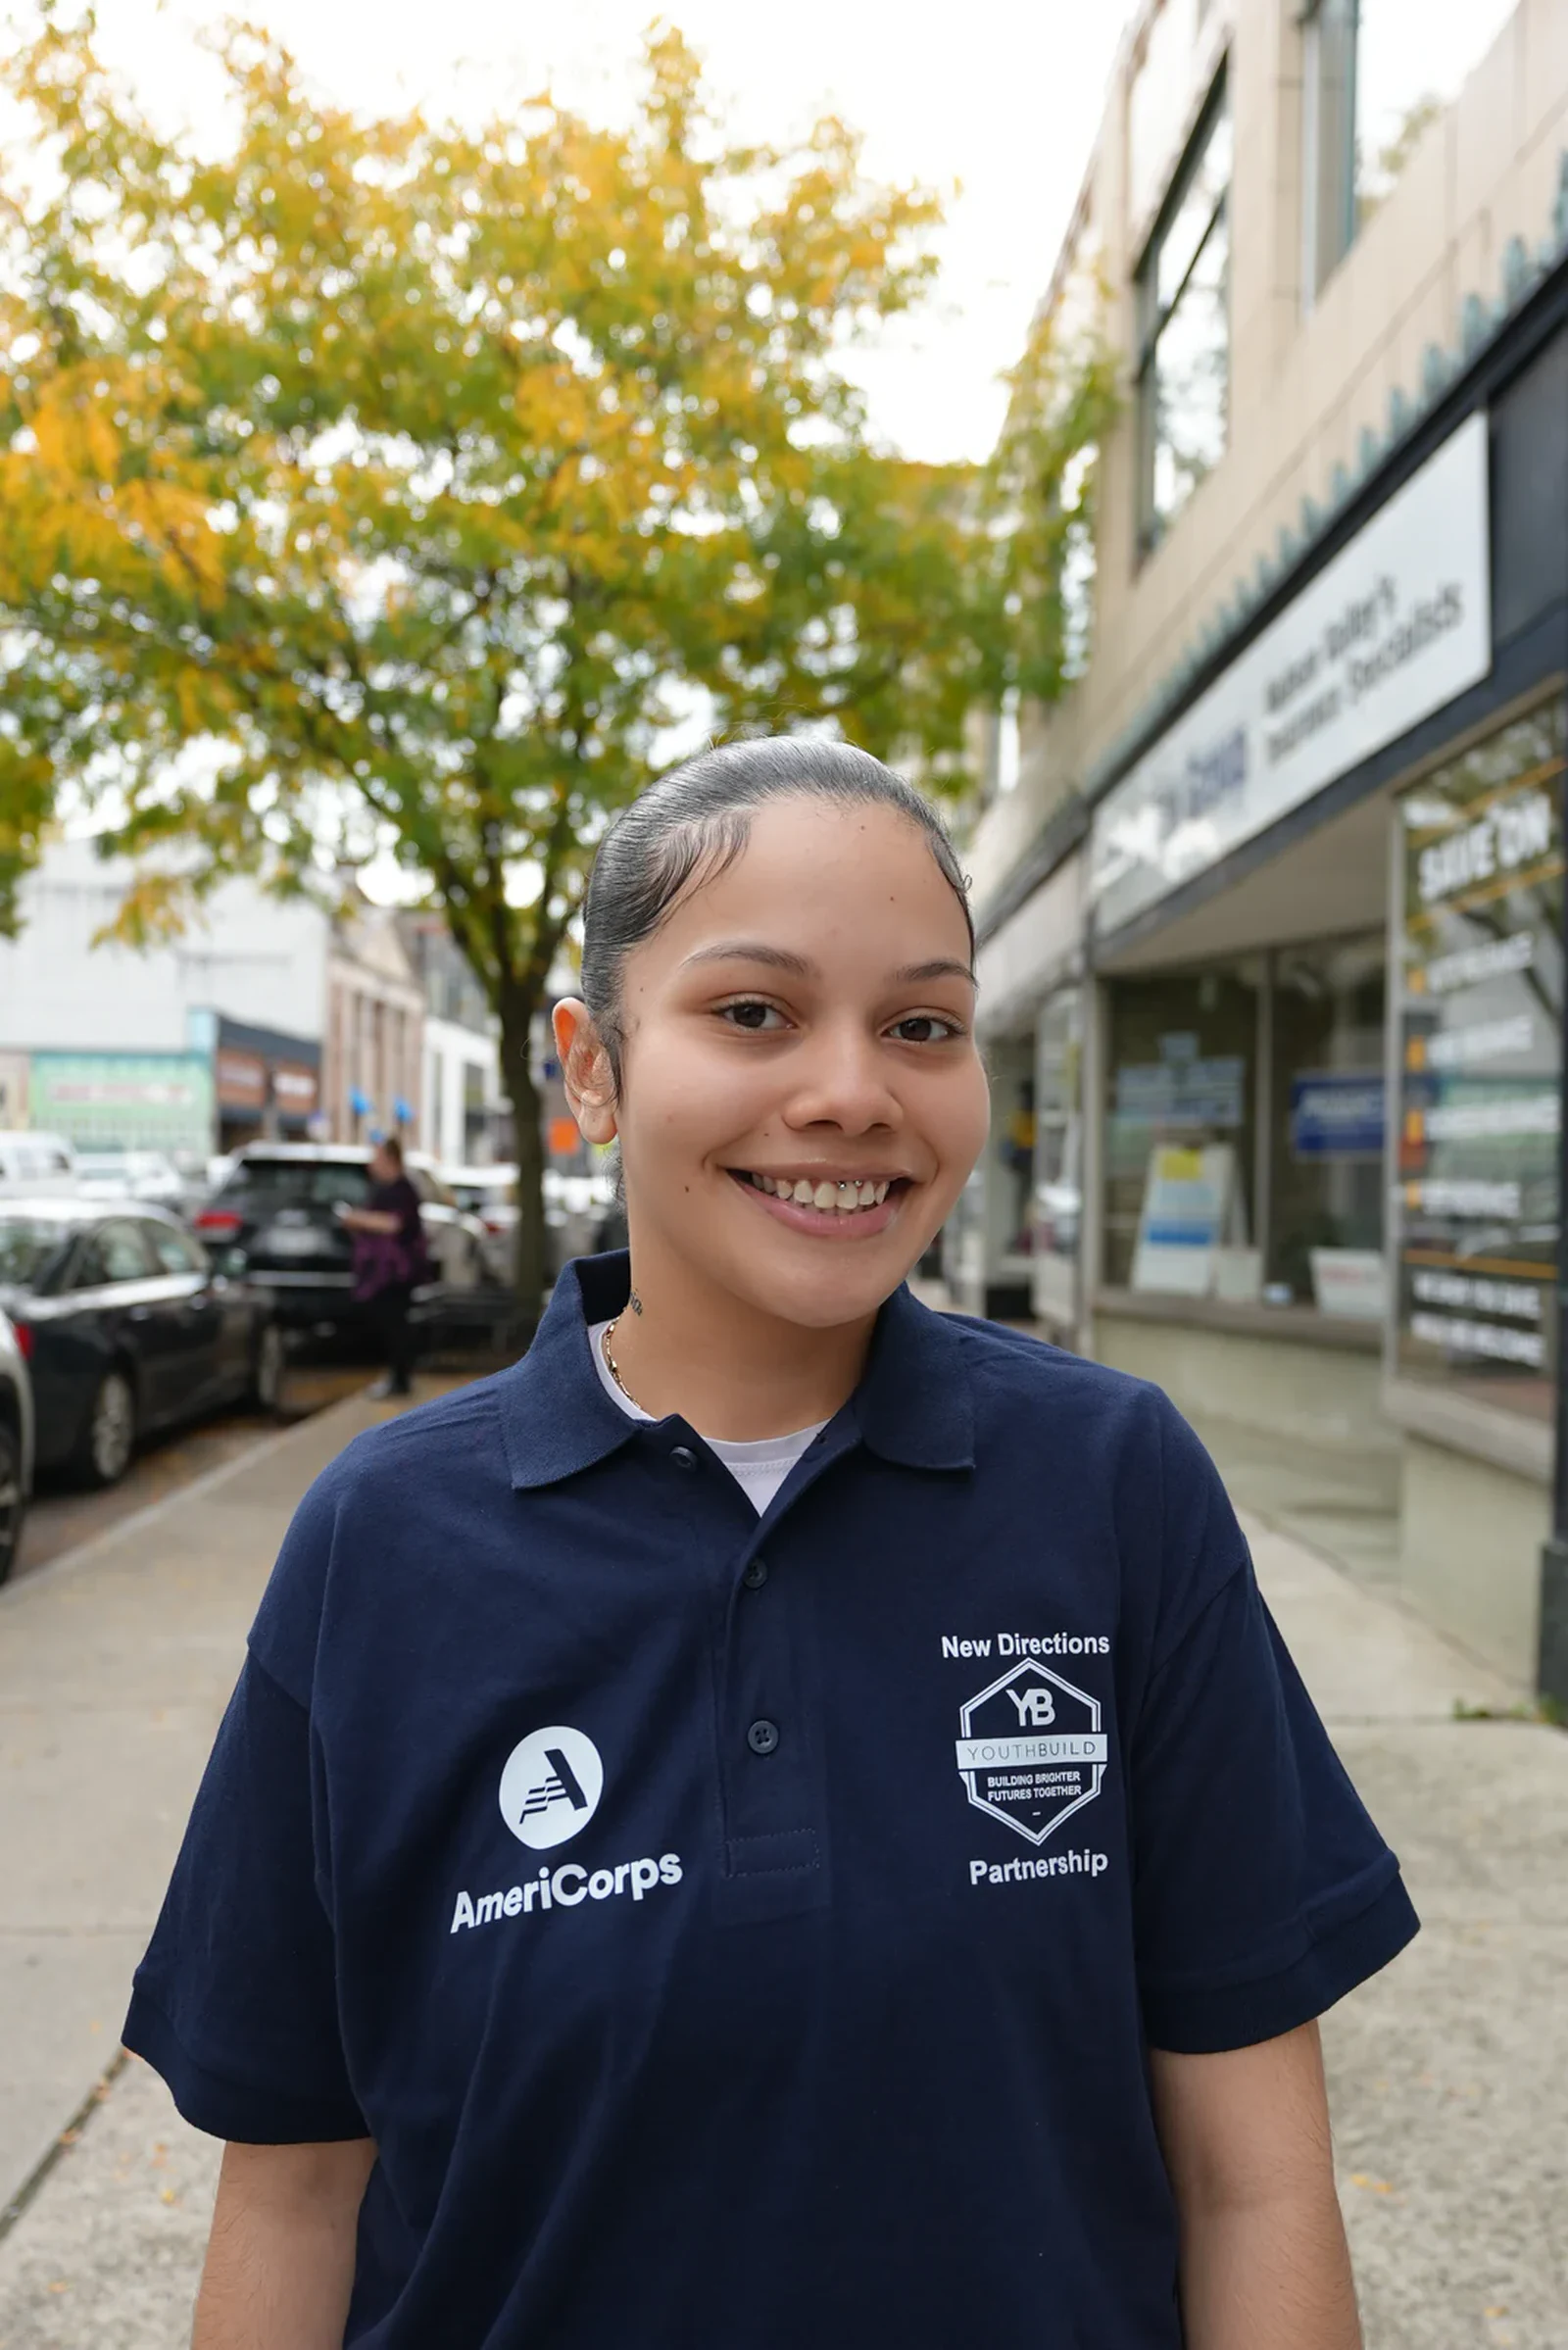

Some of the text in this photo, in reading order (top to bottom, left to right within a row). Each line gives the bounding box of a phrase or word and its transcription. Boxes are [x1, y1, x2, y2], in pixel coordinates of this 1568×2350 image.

[941, 1632, 1110, 1658] New Directions
[1005, 1688, 1056, 1727] YB
[966, 1740, 1097, 1761] YOUTHBUILD
[987, 1770, 1081, 1788] BUILDING BRIGHTER
[987, 1785, 1082, 1802] FUTURES TOGETHER
[968, 1848, 1109, 1885] Partnership
[450, 1852, 684, 1934] AmeriCorps
